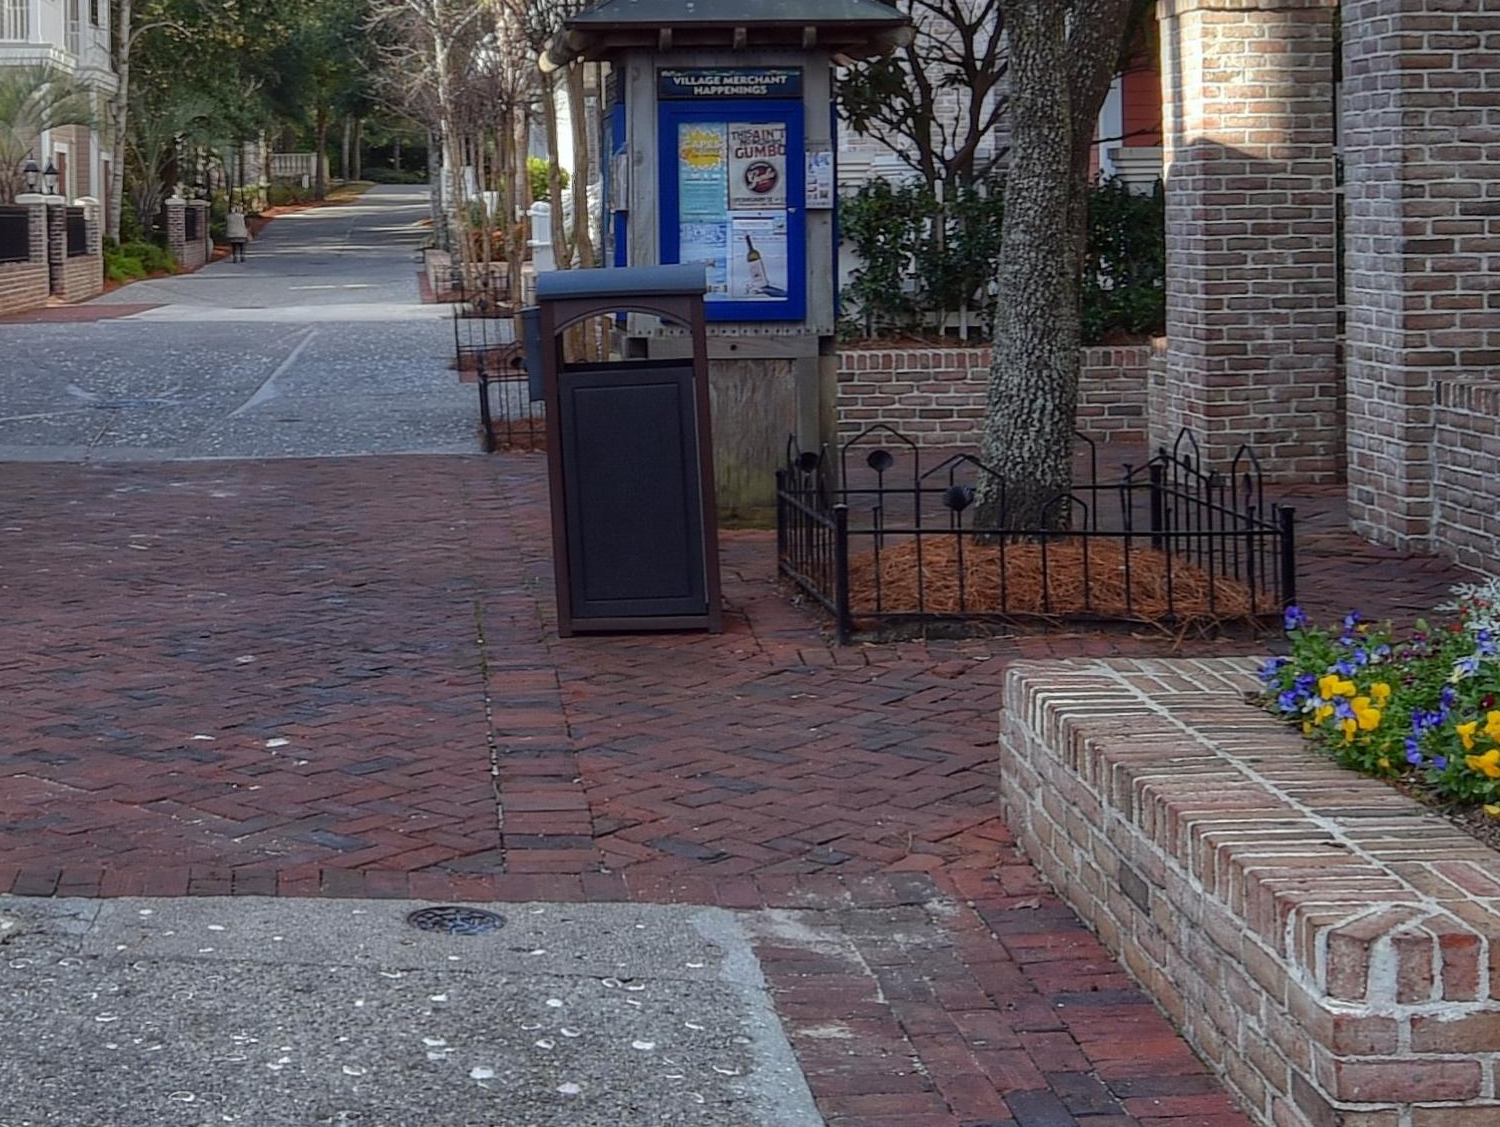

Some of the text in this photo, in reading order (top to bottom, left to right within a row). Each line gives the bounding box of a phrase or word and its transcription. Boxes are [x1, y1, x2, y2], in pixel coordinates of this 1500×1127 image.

[673, 75, 788, 85] VILLAGE MERCHANT
[693, 85, 767, 95] HAPPENINGS
[735, 144, 787, 159] GUMBO
